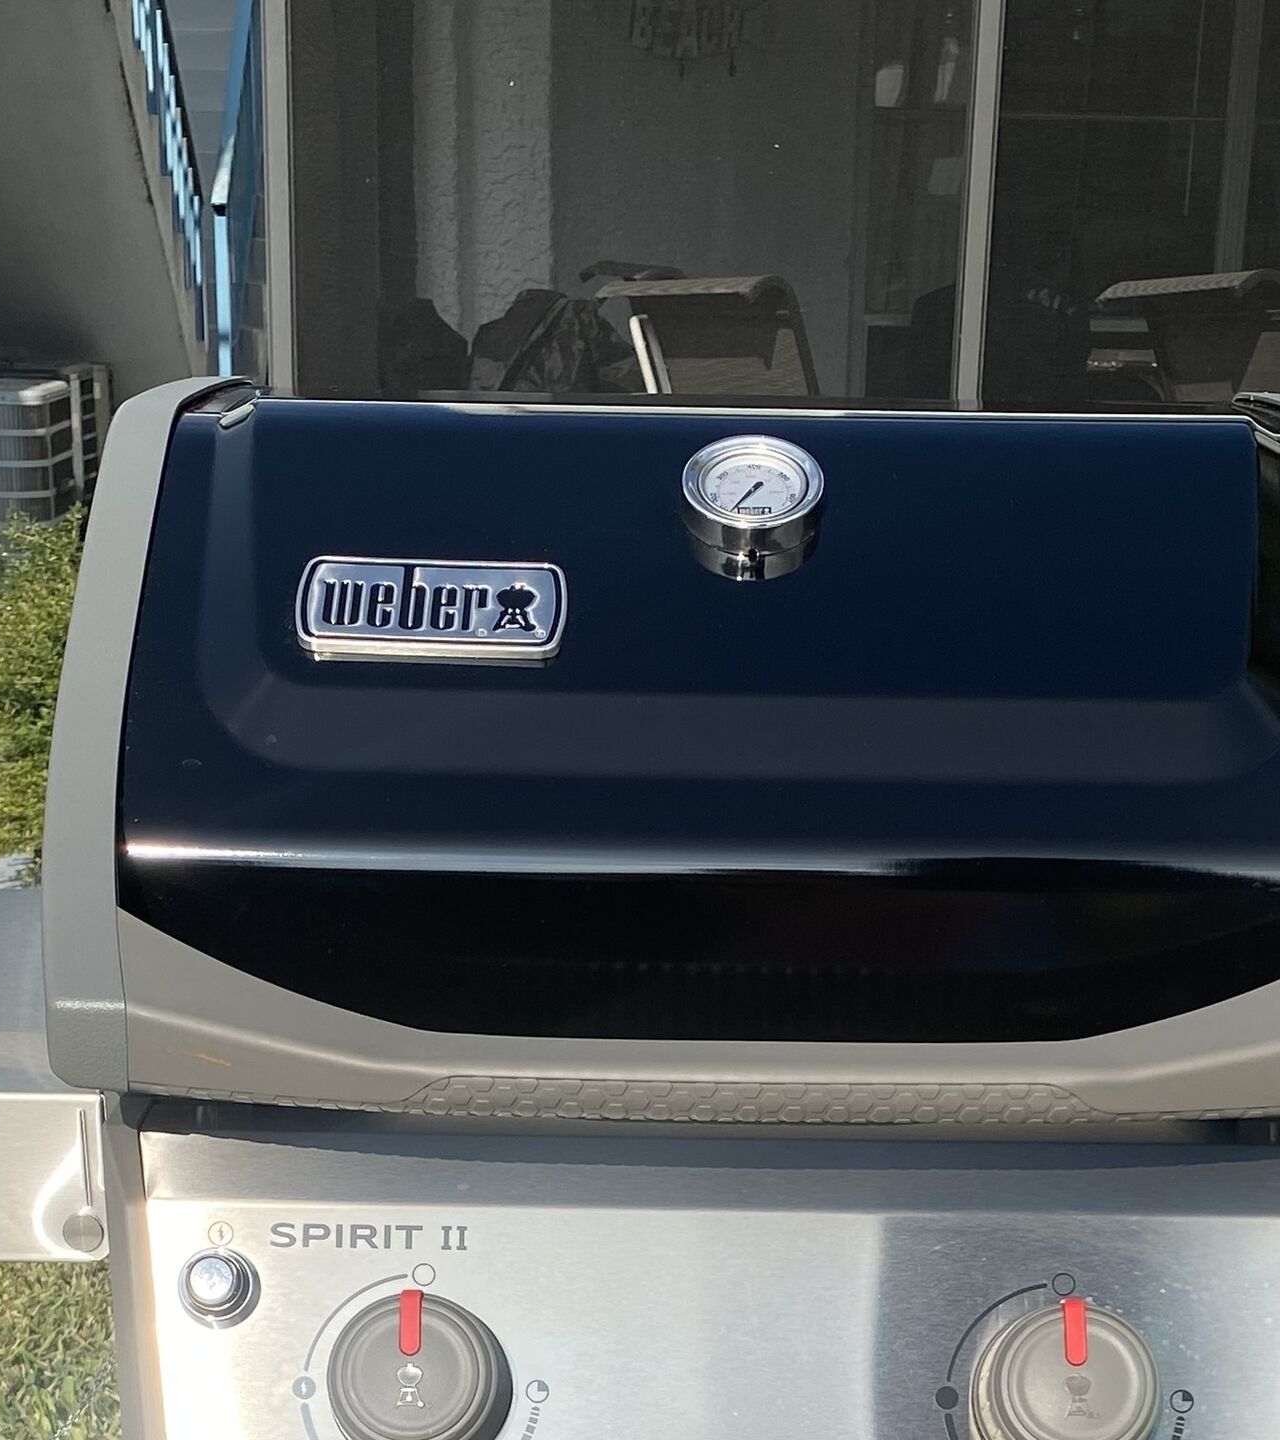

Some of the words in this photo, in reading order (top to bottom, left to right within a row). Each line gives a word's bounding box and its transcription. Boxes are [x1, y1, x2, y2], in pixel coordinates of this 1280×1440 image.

[321, 567, 492, 632] weber
[269, 1222, 424, 1250] SPIRIT
[440, 1225, 468, 1251] II
